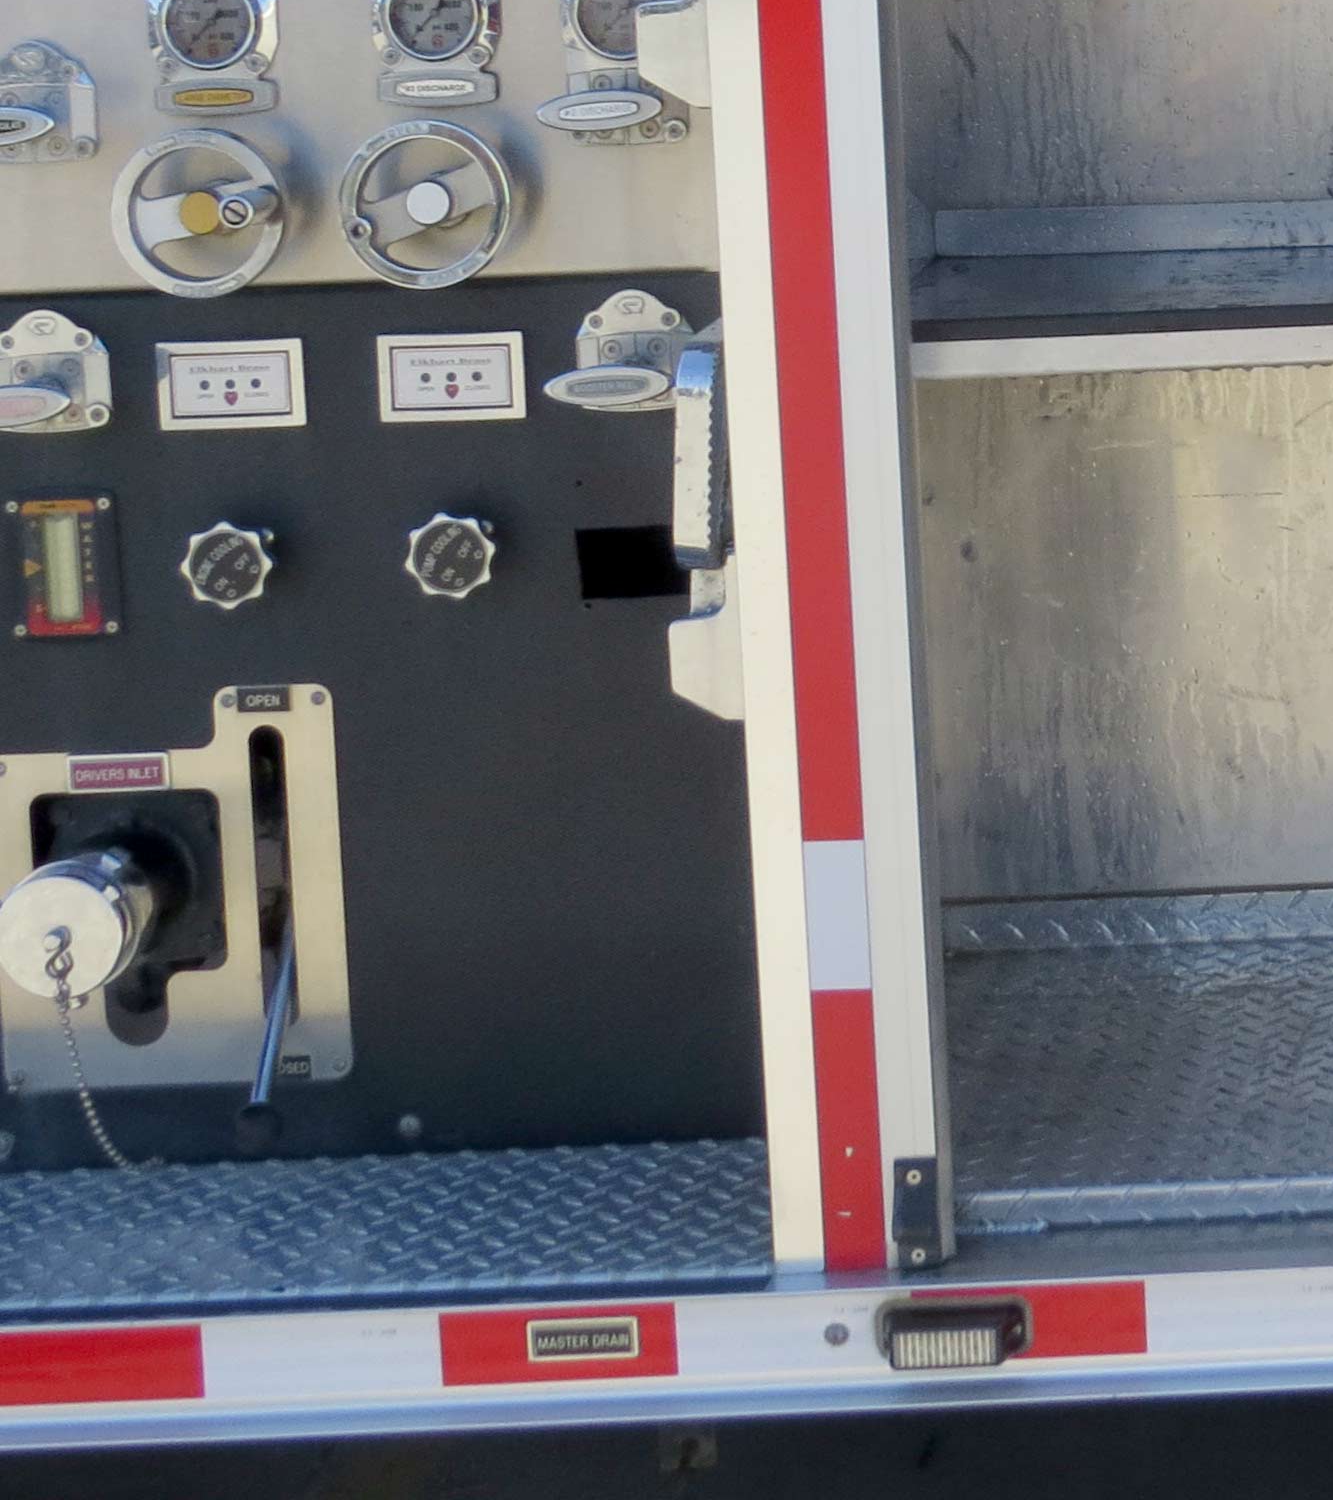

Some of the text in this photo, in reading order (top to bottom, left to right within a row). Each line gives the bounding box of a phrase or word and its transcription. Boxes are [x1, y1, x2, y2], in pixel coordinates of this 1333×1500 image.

[416, 83, 467, 93] DISCHARGE
[581, 104, 633, 116] DISCHARGE
[189, 363, 271, 375] Elkhart Brass
[410, 356, 491, 367] Elkhart Brass
[420, 525, 462, 578] PUMP COOLING
[457, 540, 472, 558] OFF
[195, 534, 243, 586] ENGINE COOLING
[234, 552, 249, 570] OFF
[441, 567, 455, 582] ON
[214, 576, 228, 592] ON
[245, 695, 281, 708] OPEN
[75, 765, 159, 782] DRIVERS INLET
[538, 1333, 630, 1350] MASTER DRAIN
